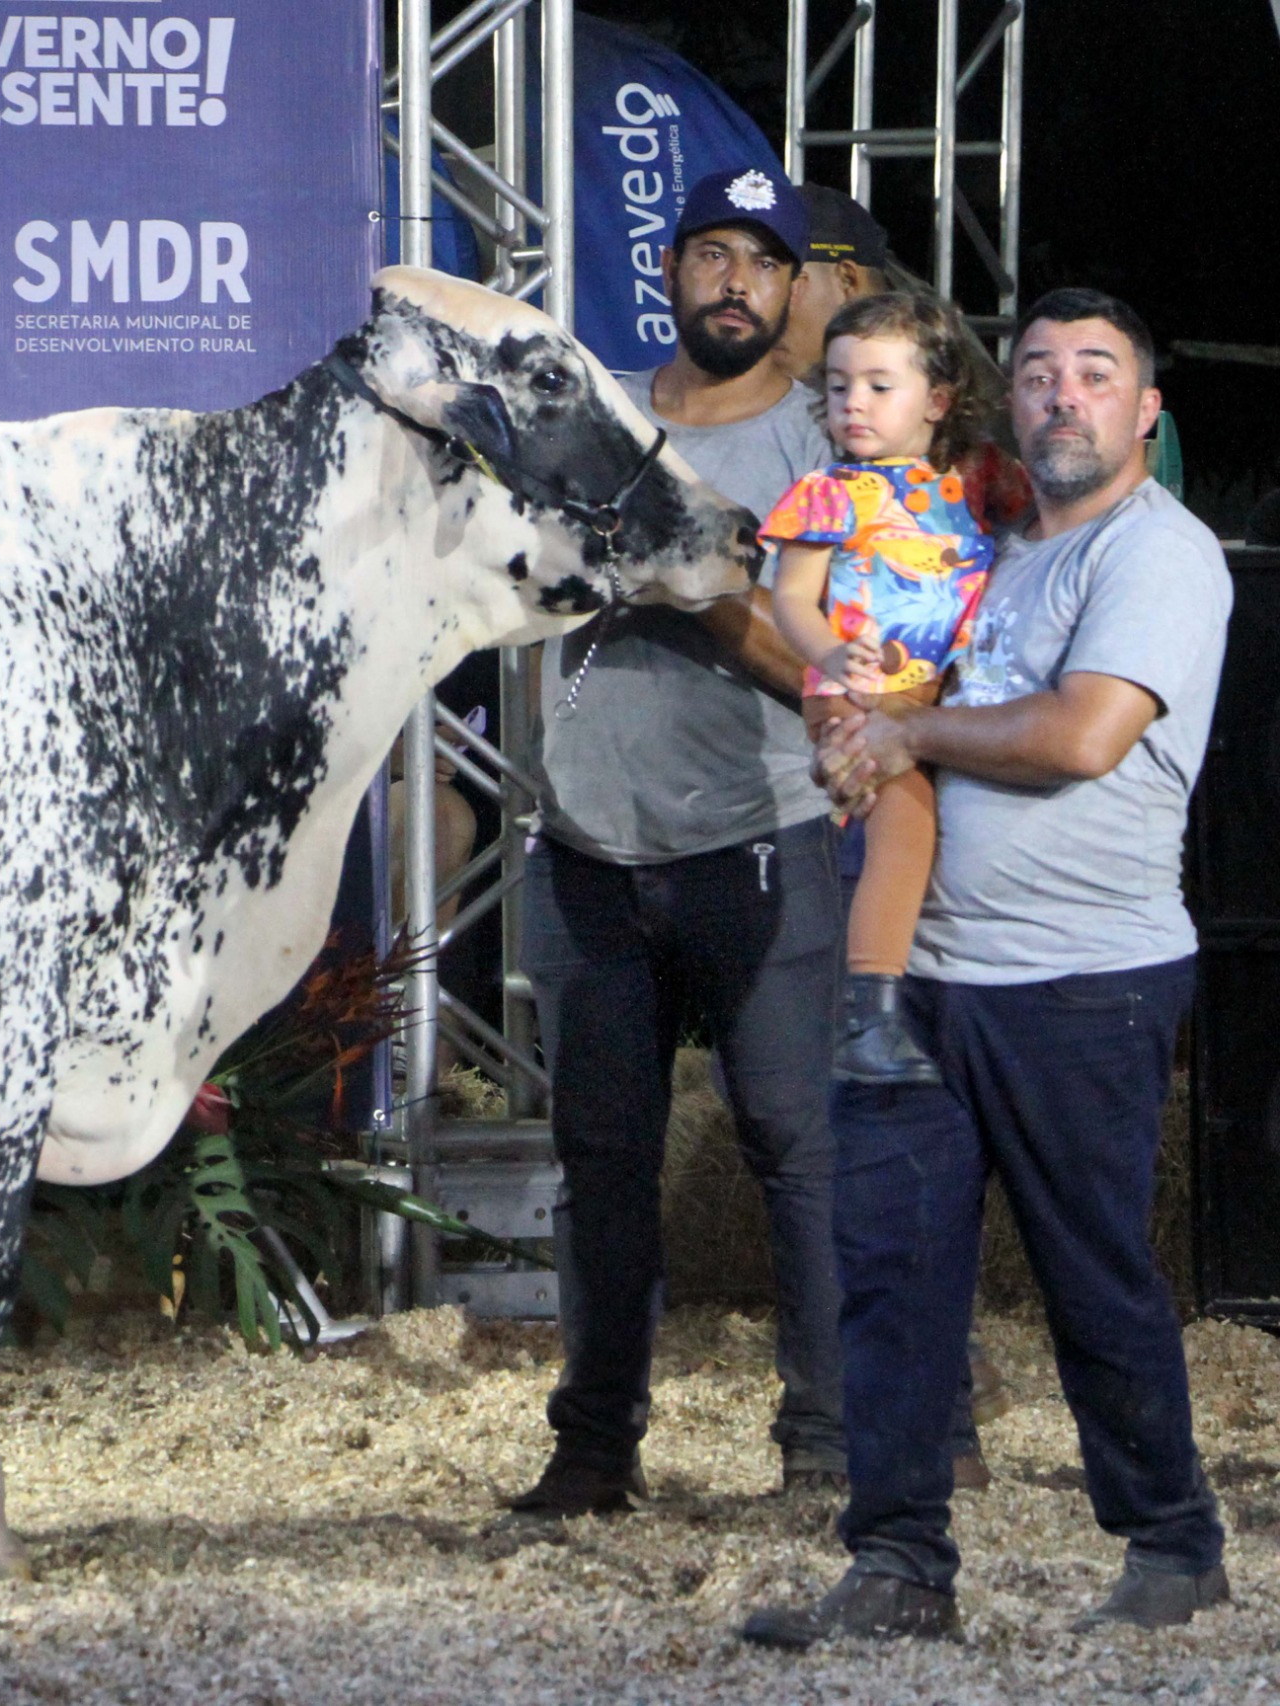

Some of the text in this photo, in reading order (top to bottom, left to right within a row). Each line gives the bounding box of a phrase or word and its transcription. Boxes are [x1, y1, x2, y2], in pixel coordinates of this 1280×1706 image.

[668, 124, 685, 193] Energética
[602, 82, 679, 344] azevedo
[12, 218, 251, 304] SMDR
[14, 314, 252, 331] SECRETARIA MUNICIPAL DE
[15, 337, 257, 353] DESENVOLVIMENTO RURAL
